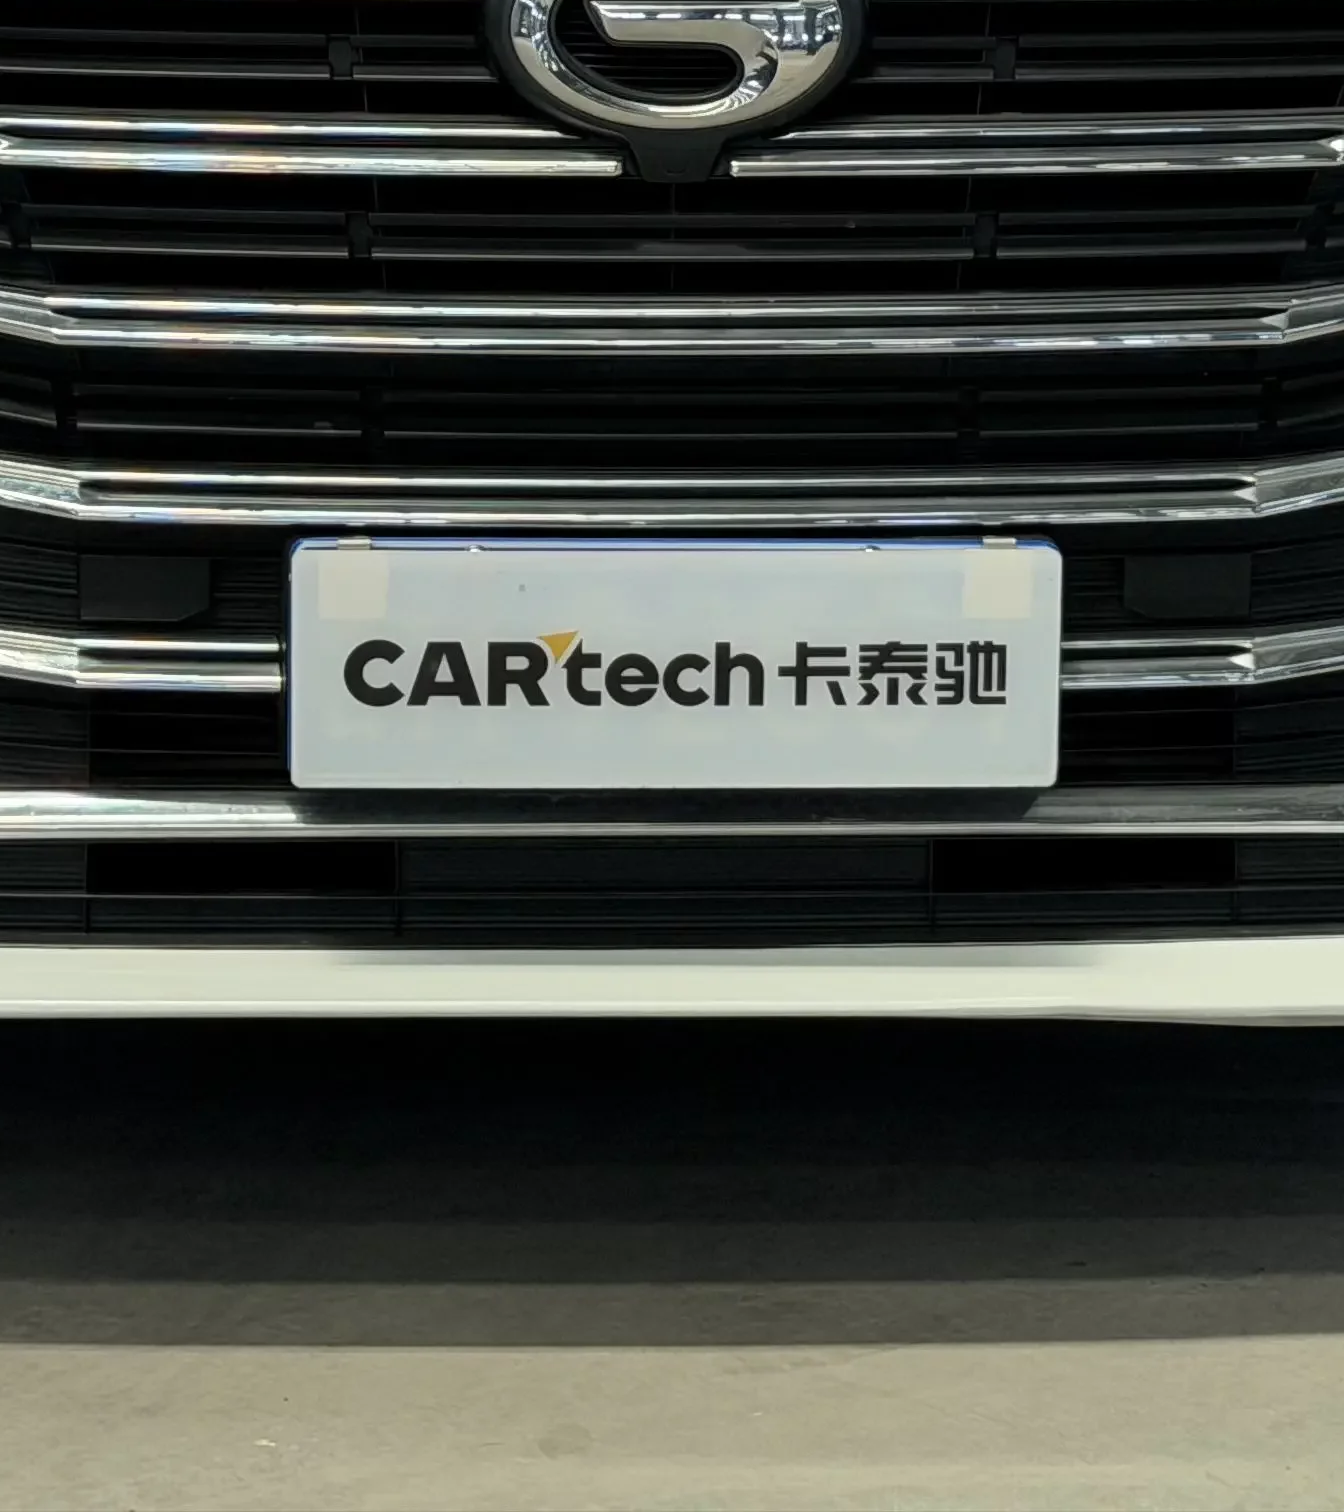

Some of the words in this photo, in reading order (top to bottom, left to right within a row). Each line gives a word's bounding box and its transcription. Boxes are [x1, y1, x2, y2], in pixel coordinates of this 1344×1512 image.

[343, 639, 765, 708] CARtech
[777, 640, 1007, 706] 卡泰驰
